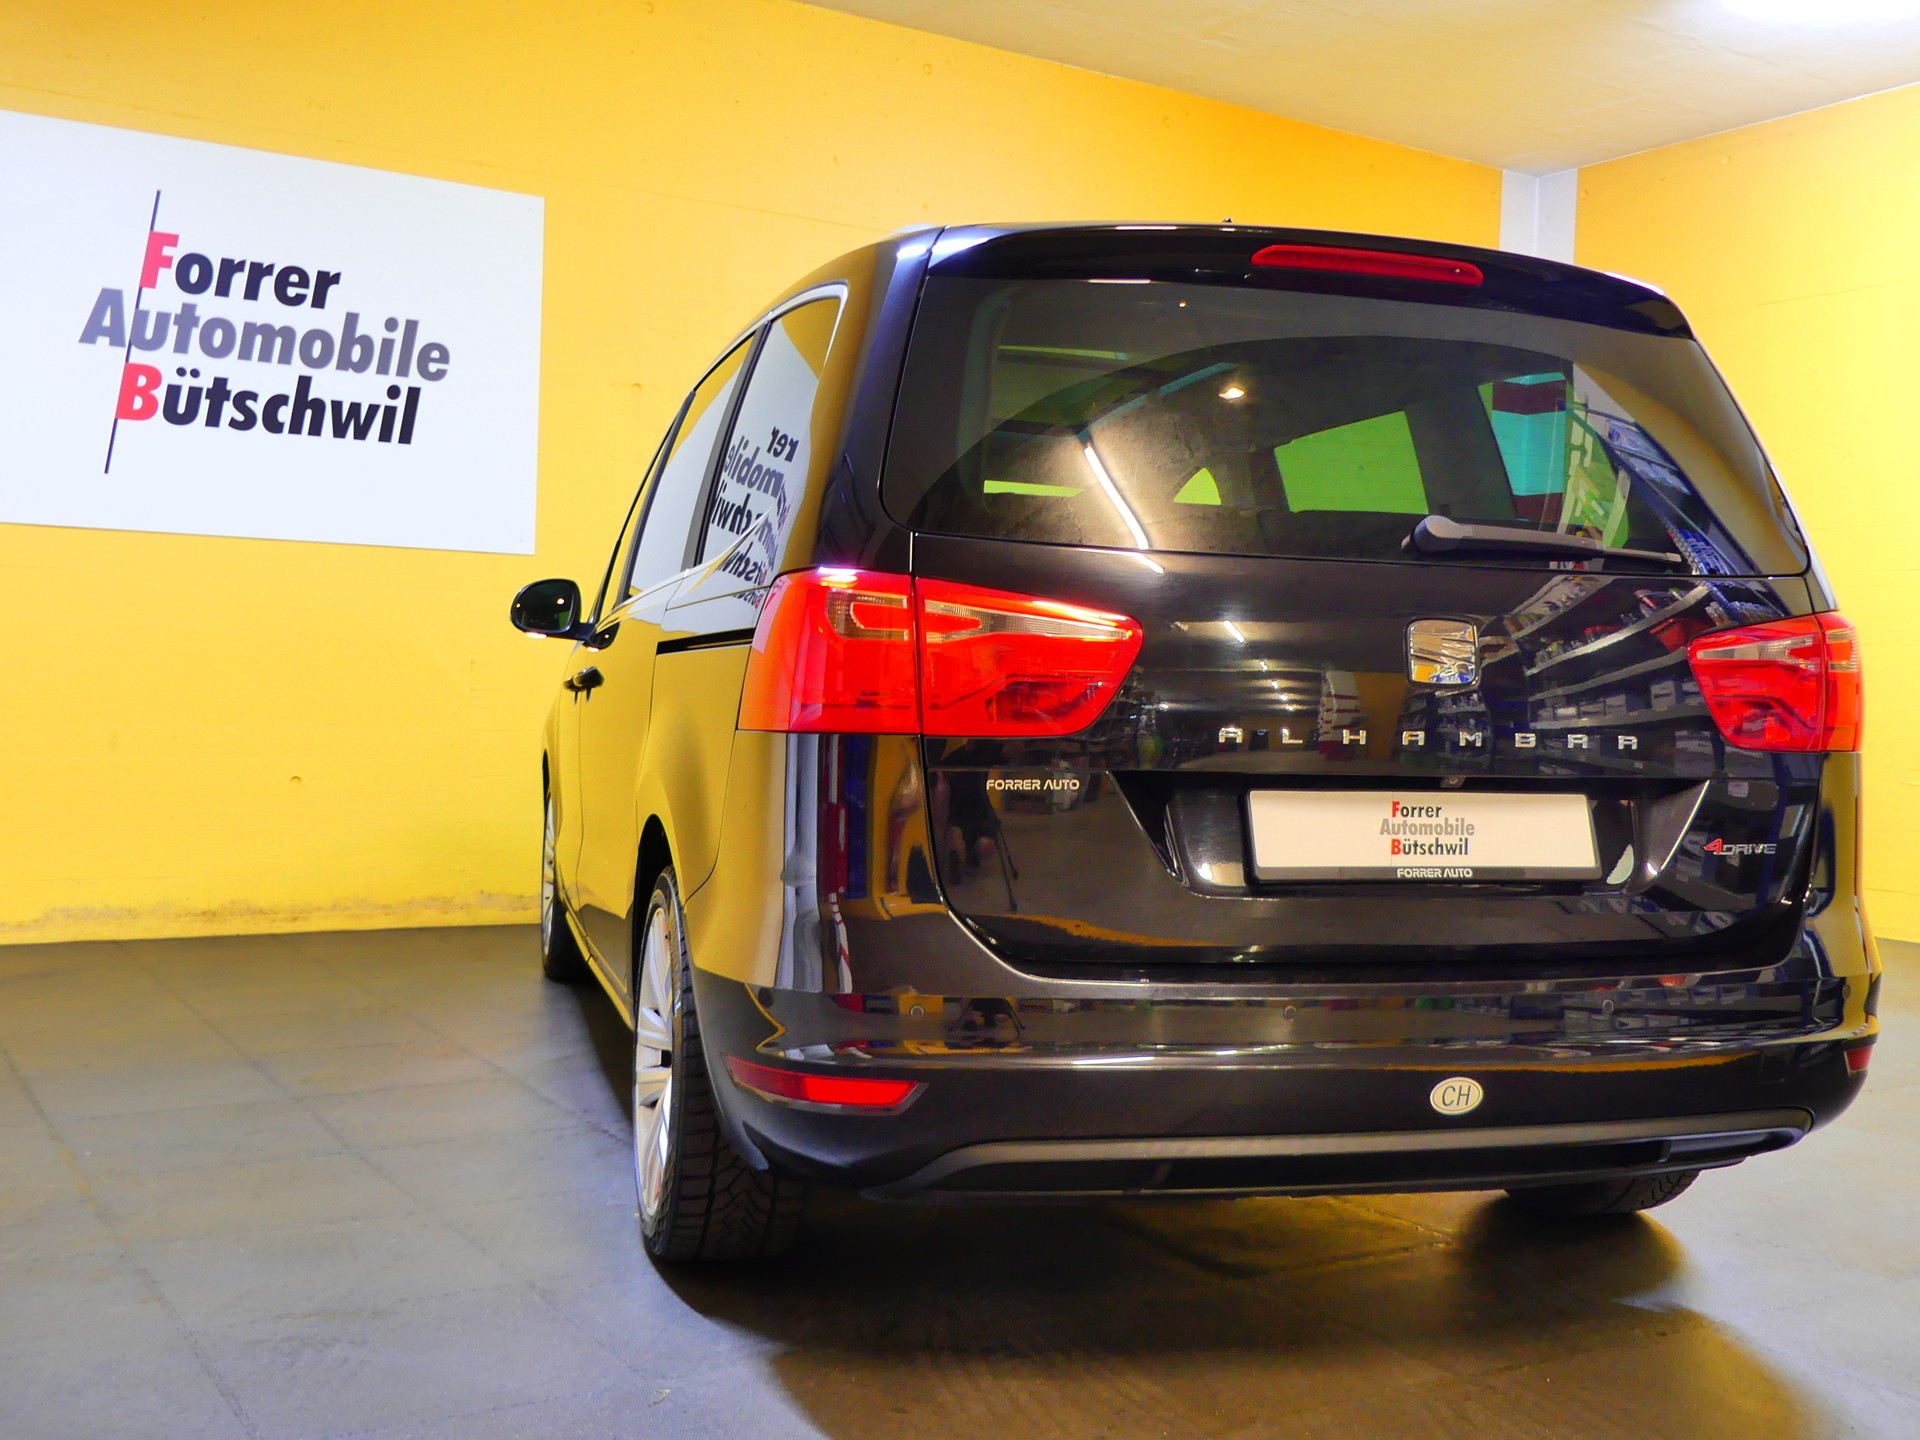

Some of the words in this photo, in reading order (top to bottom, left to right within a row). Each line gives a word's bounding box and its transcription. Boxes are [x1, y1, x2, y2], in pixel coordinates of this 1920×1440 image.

[139, 231, 341, 309] Forrer
[78, 287, 450, 382] Automobile
[115, 362, 421, 444] Bütschwil
[1218, 727, 1638, 751] ALHAMBRA
[986, 779, 1041, 791] FORRER
[1043, 779, 1080, 791] AUTO
[1391, 801, 1442, 818] Forrer
[1380, 818, 1475, 836] Automobile
[1391, 838, 1469, 856] Bütschwil
[1397, 868, 1442, 879] FORRER
[1443, 868, 1473, 879] AUTO
[1441, 1085, 1472, 1107] CH
